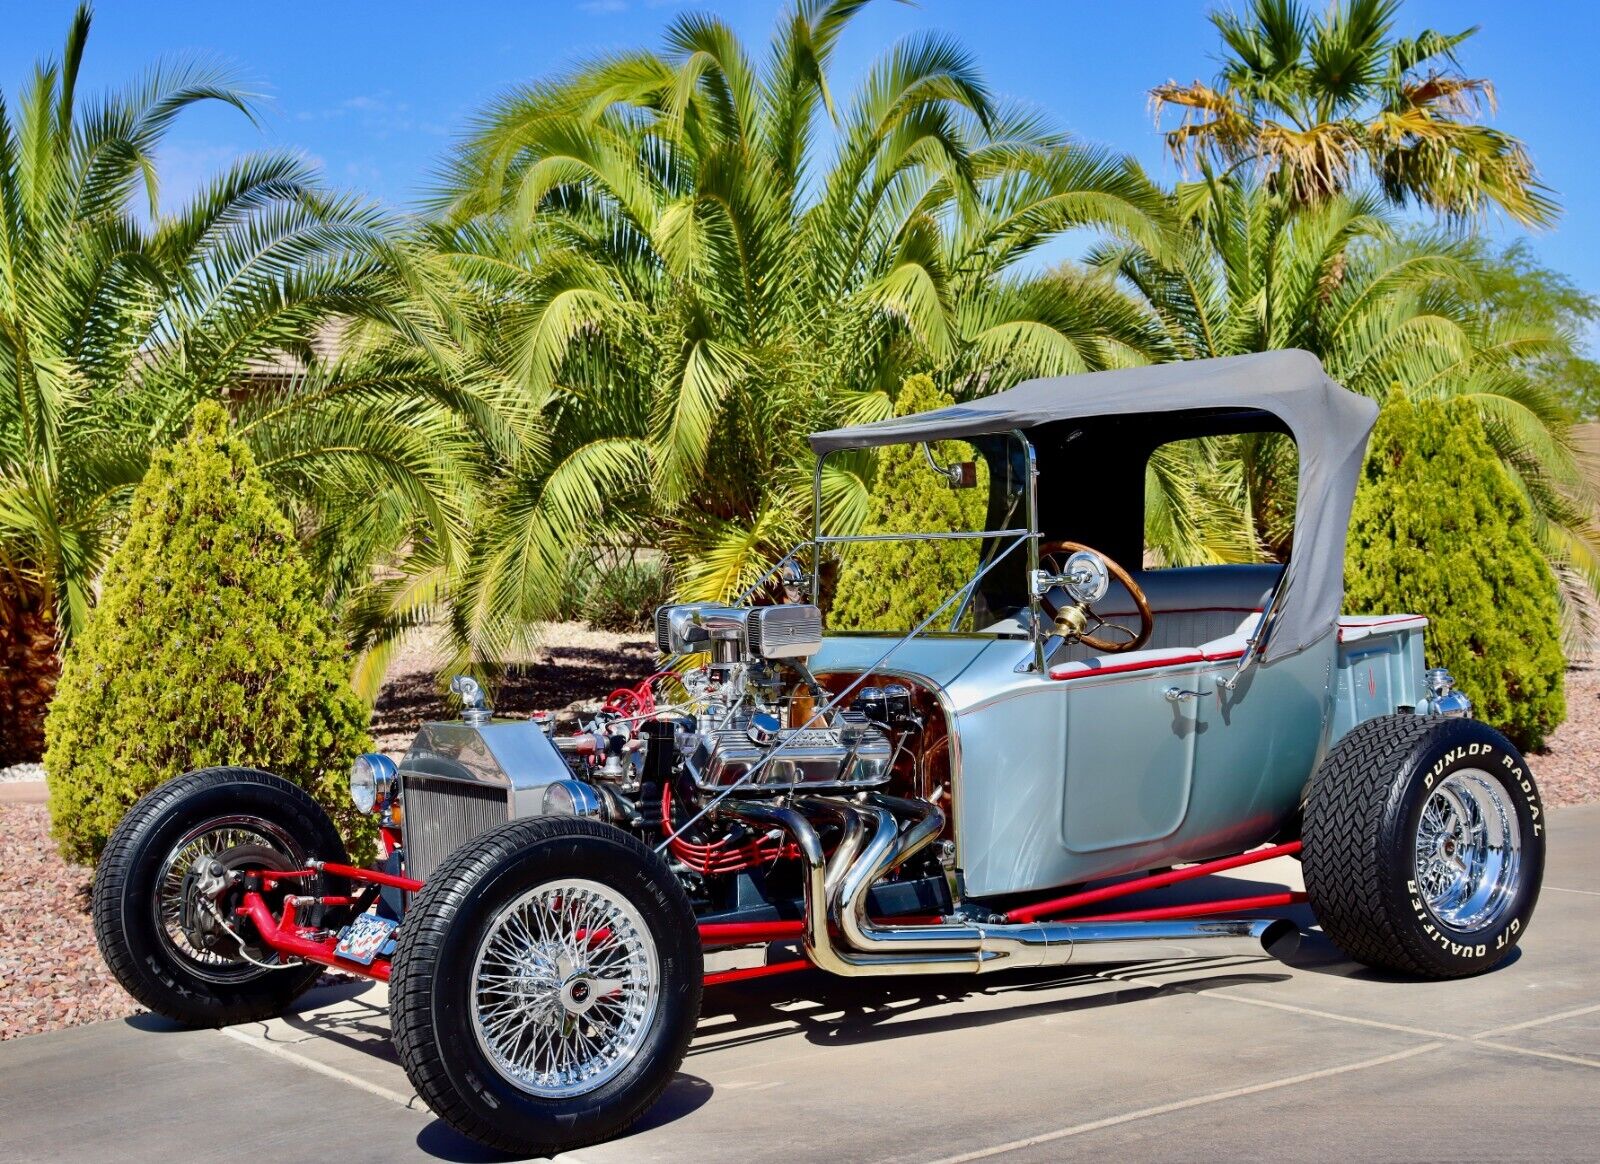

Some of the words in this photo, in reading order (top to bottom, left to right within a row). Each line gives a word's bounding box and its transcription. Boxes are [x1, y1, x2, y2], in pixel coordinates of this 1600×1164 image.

[1424, 743, 1492, 789] DUNLOP
[1502, 755, 1542, 837] RADIAL
[1407, 880, 1486, 957] QUALIFIER
[1496, 918, 1520, 950] G/T
